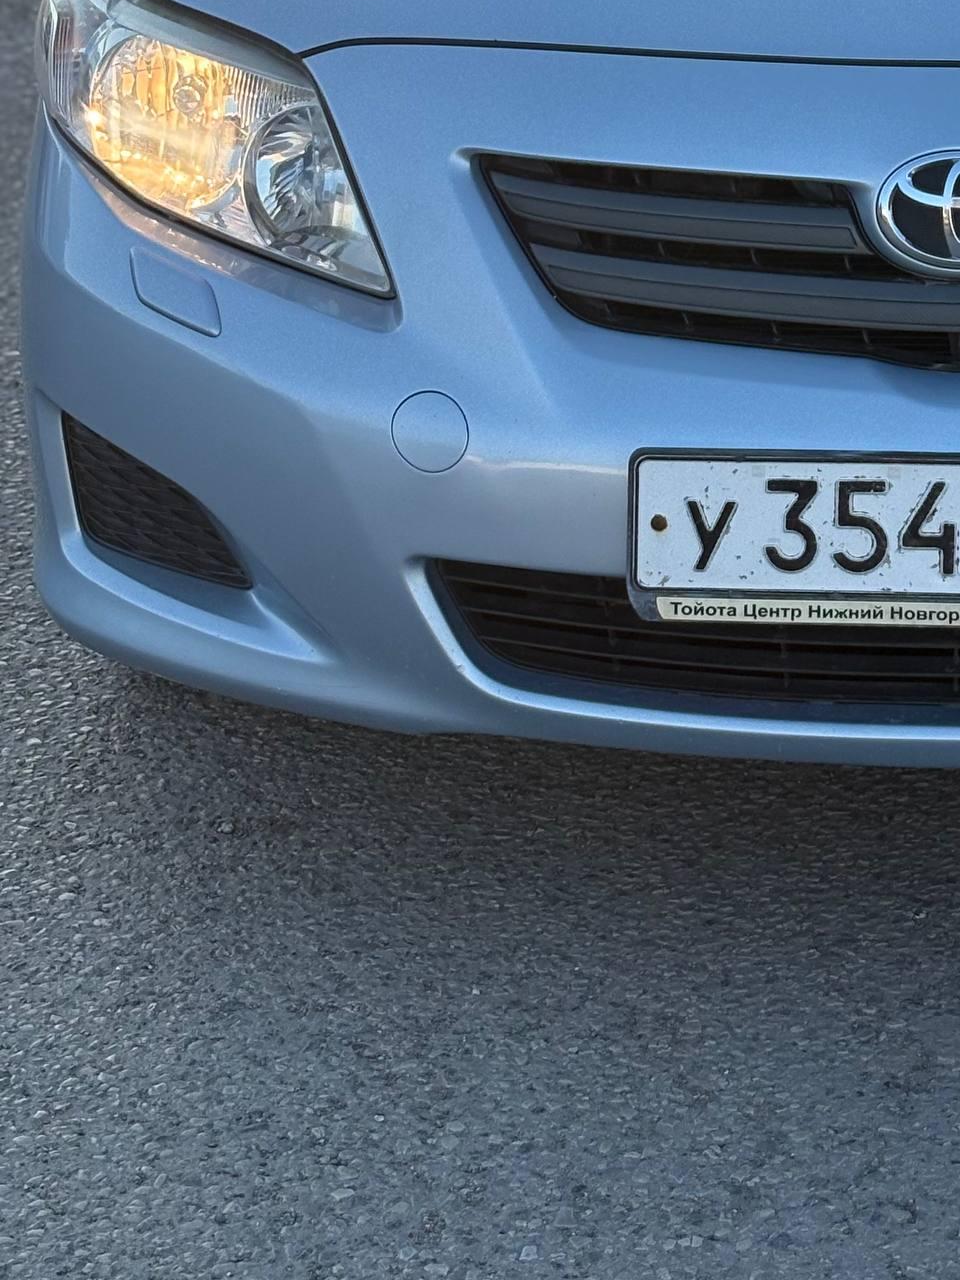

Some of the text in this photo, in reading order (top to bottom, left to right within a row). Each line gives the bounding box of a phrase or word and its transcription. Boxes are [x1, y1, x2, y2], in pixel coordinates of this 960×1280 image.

[765, 478, 956, 573] 354
[670, 601, 737, 617] Тойота
[743, 603, 802, 621] Центр
[808, 604, 884, 620] Нижний
